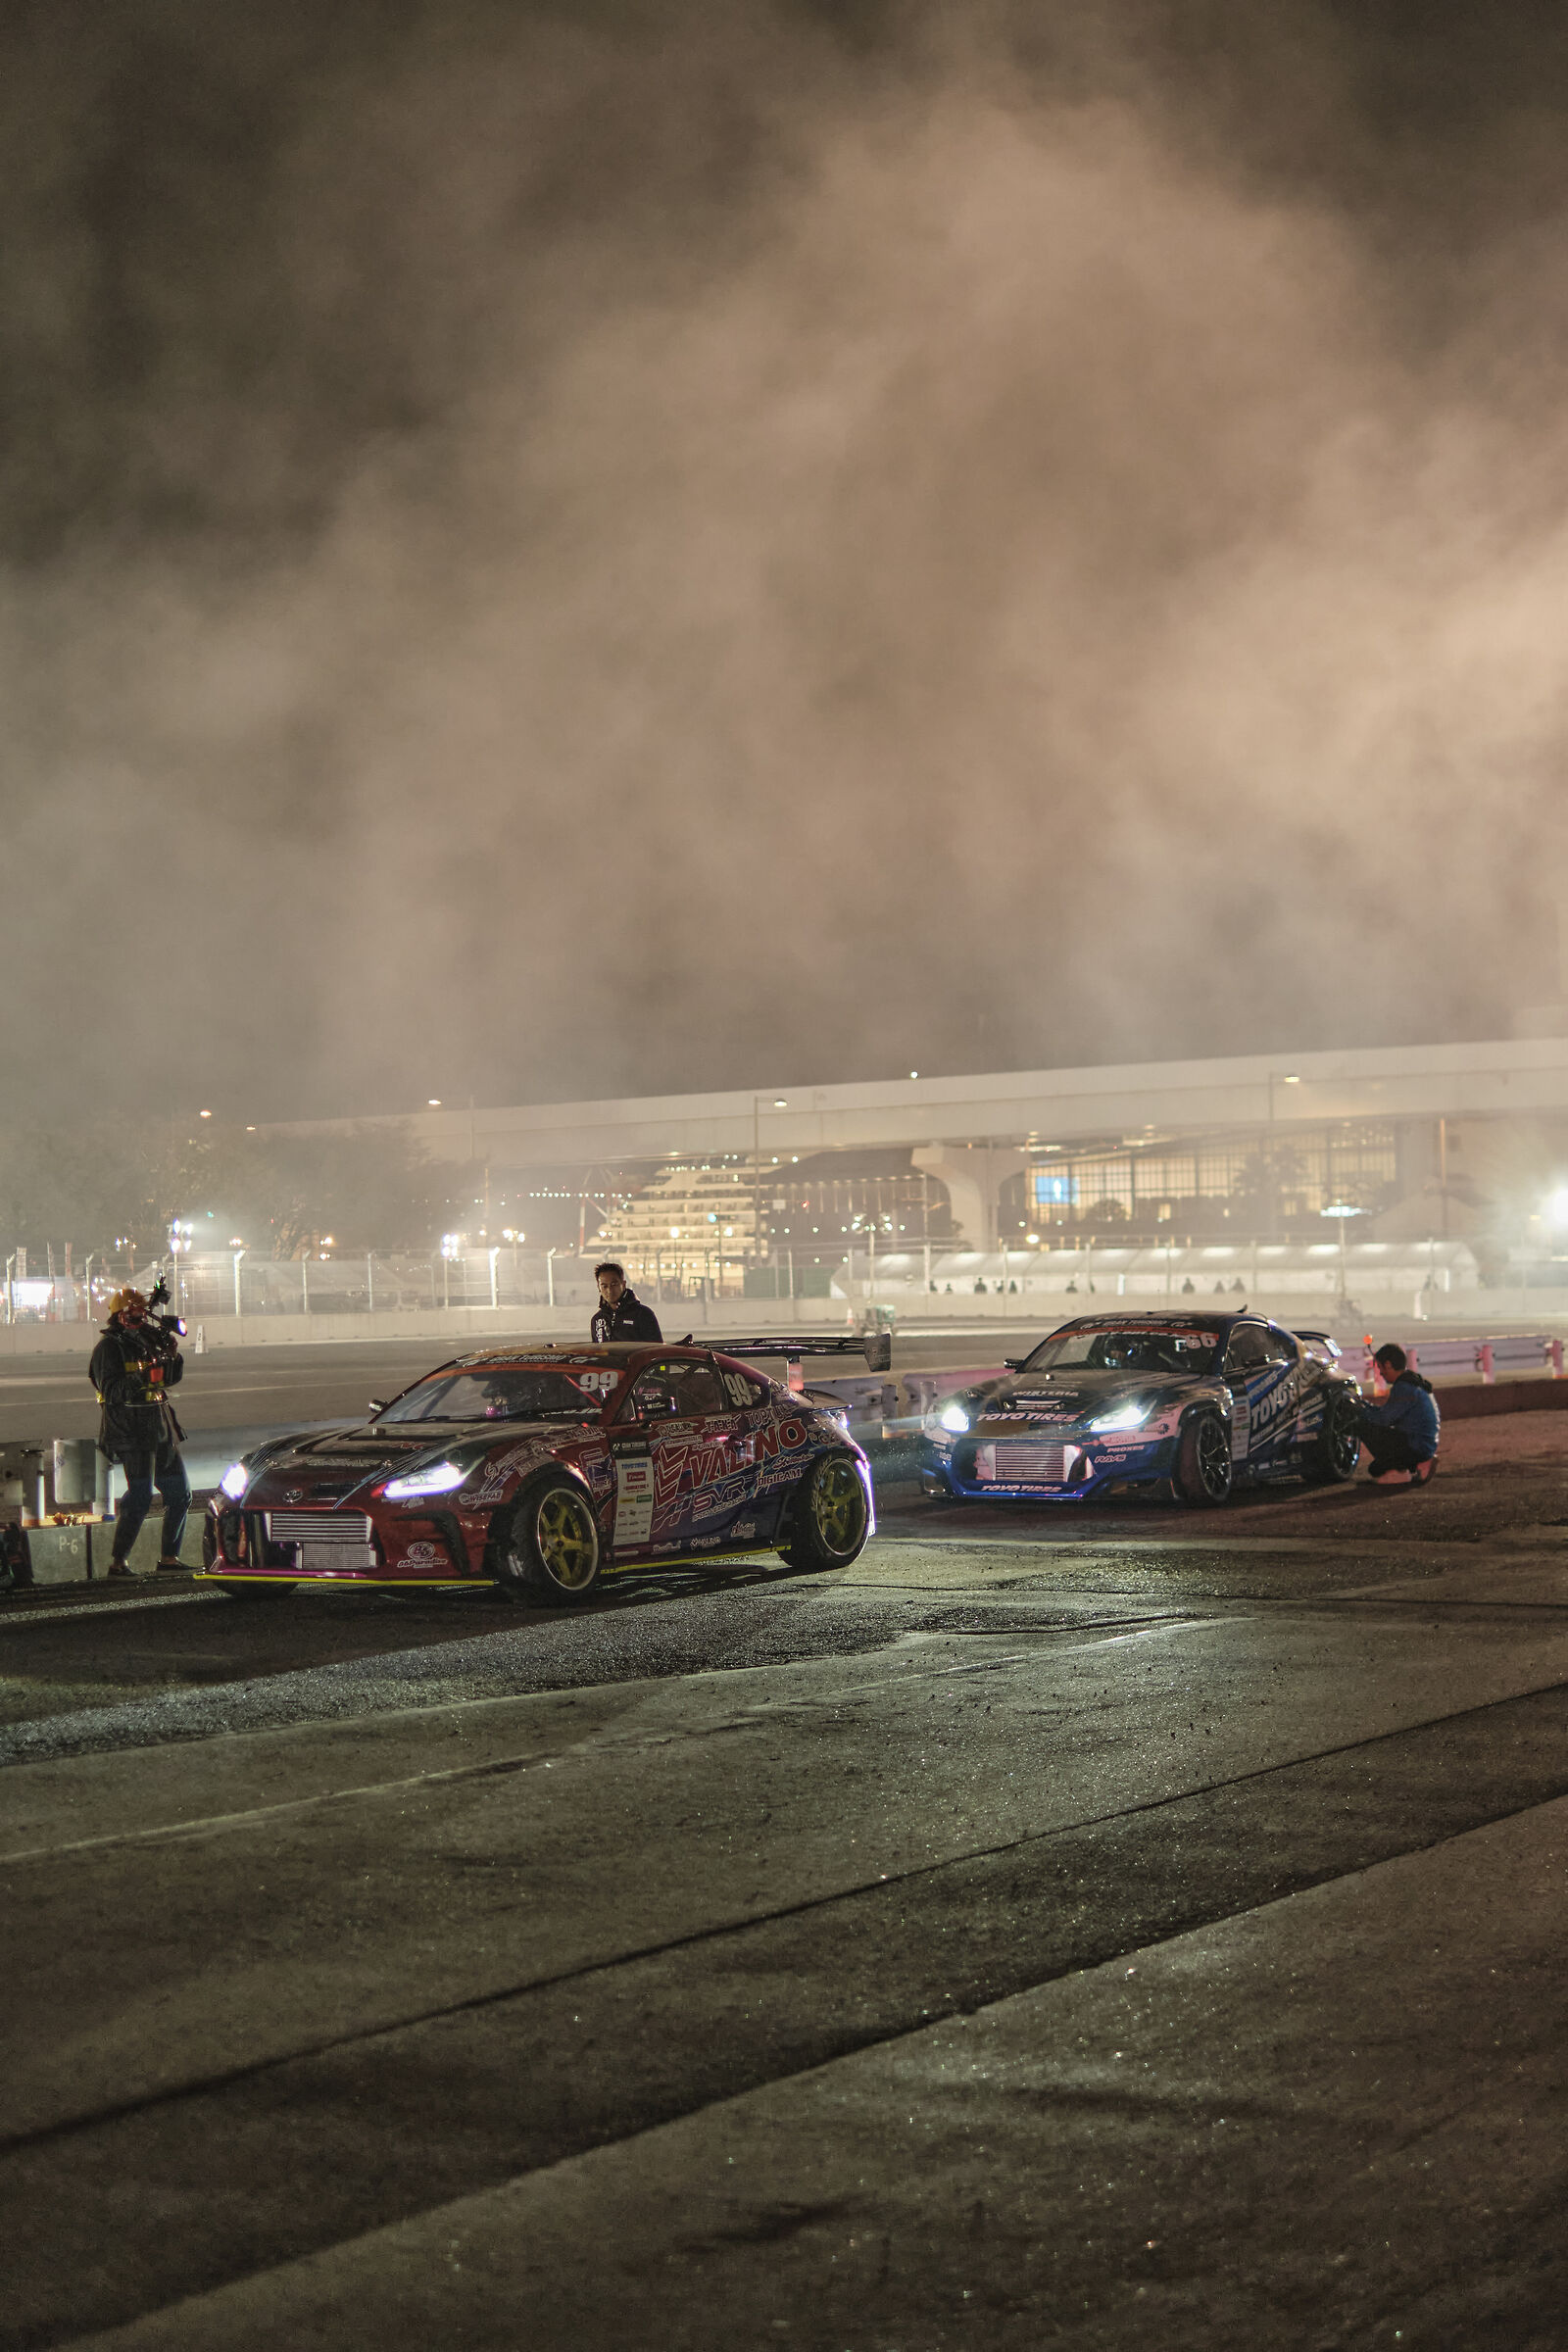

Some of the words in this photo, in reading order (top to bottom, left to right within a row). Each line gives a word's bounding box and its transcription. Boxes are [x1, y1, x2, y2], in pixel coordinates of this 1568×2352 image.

[1186, 1332, 1217, 1348] 66
[579, 1372, 618, 1392] 99
[724, 1373, 753, 1406] 99
[689, 1418, 808, 1490] VALINO
[757, 1468, 803, 1487] DIGICAM
[693, 1477, 747, 1514] SVR
[59, 1536, 78, 1554] P-6
